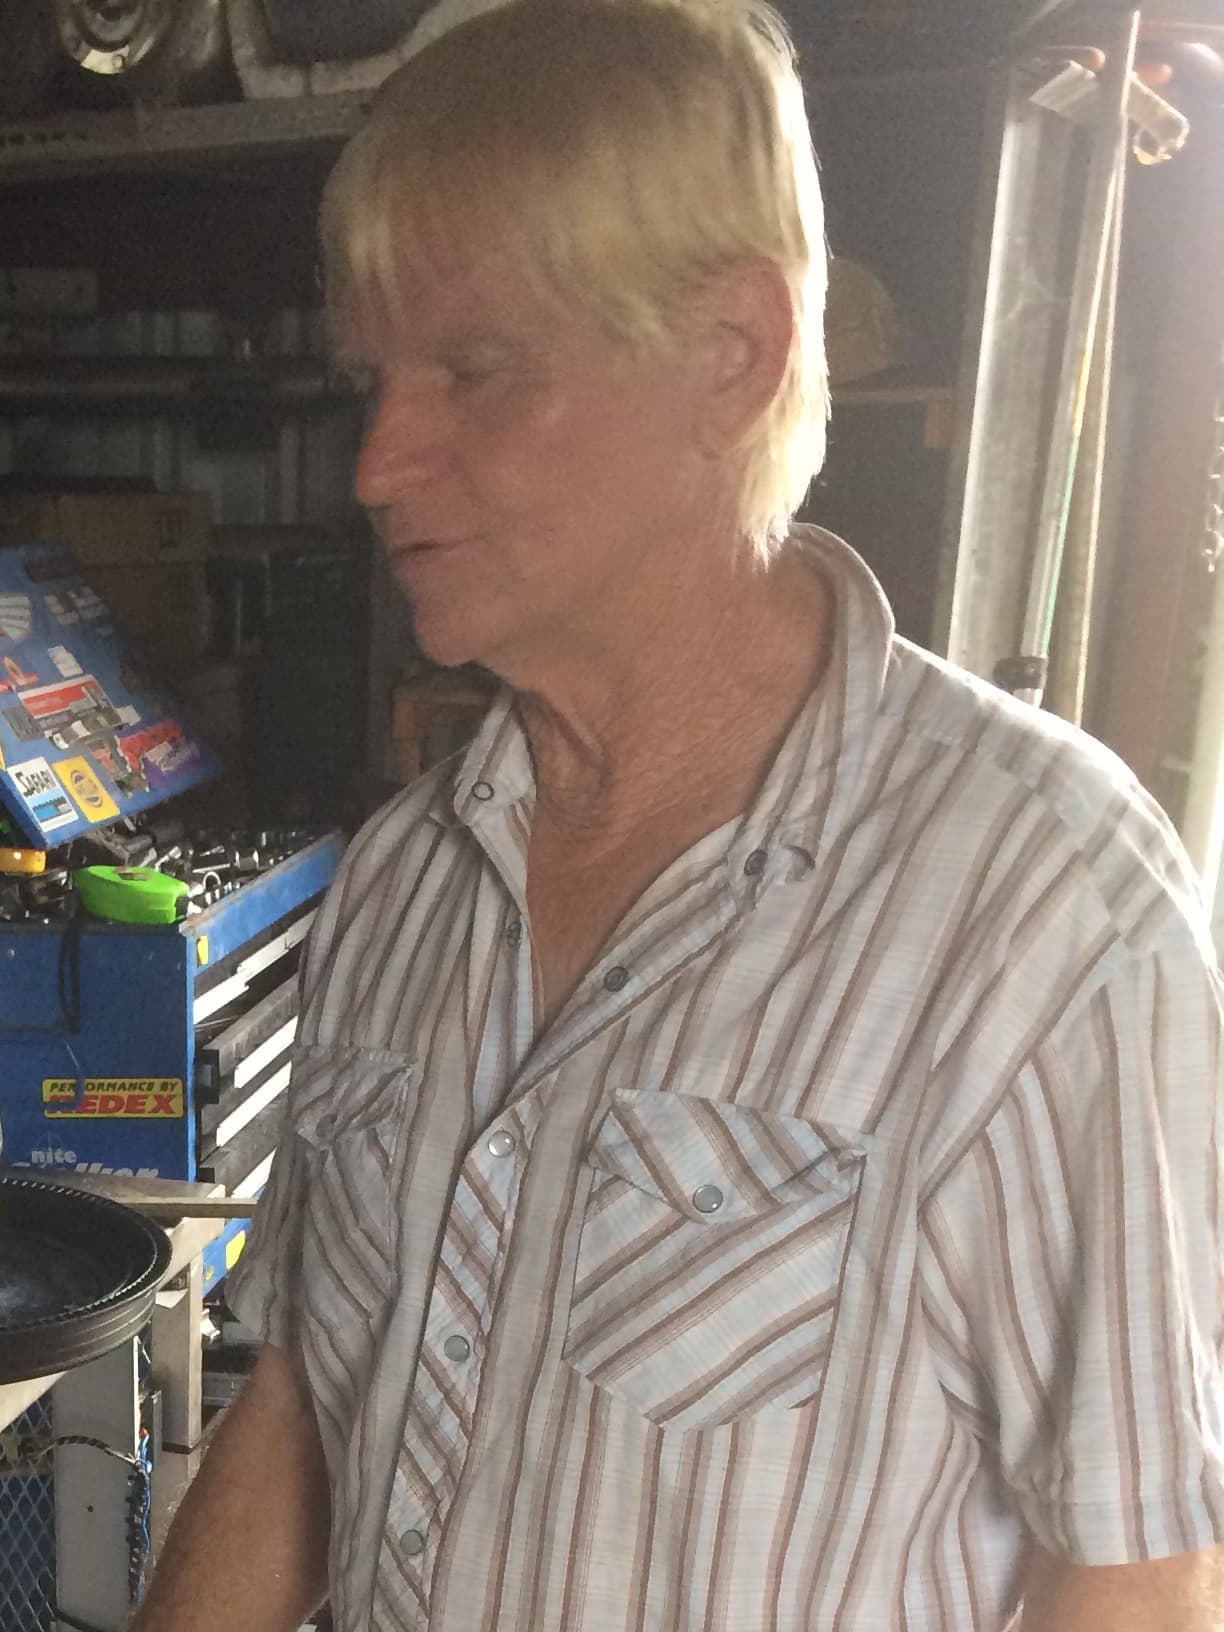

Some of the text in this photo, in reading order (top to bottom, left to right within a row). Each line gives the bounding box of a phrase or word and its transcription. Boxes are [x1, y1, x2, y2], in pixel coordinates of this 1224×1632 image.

[15, 769, 57, 797] SAFARI
[49, 1081, 178, 1092] PERORMANCE BY
